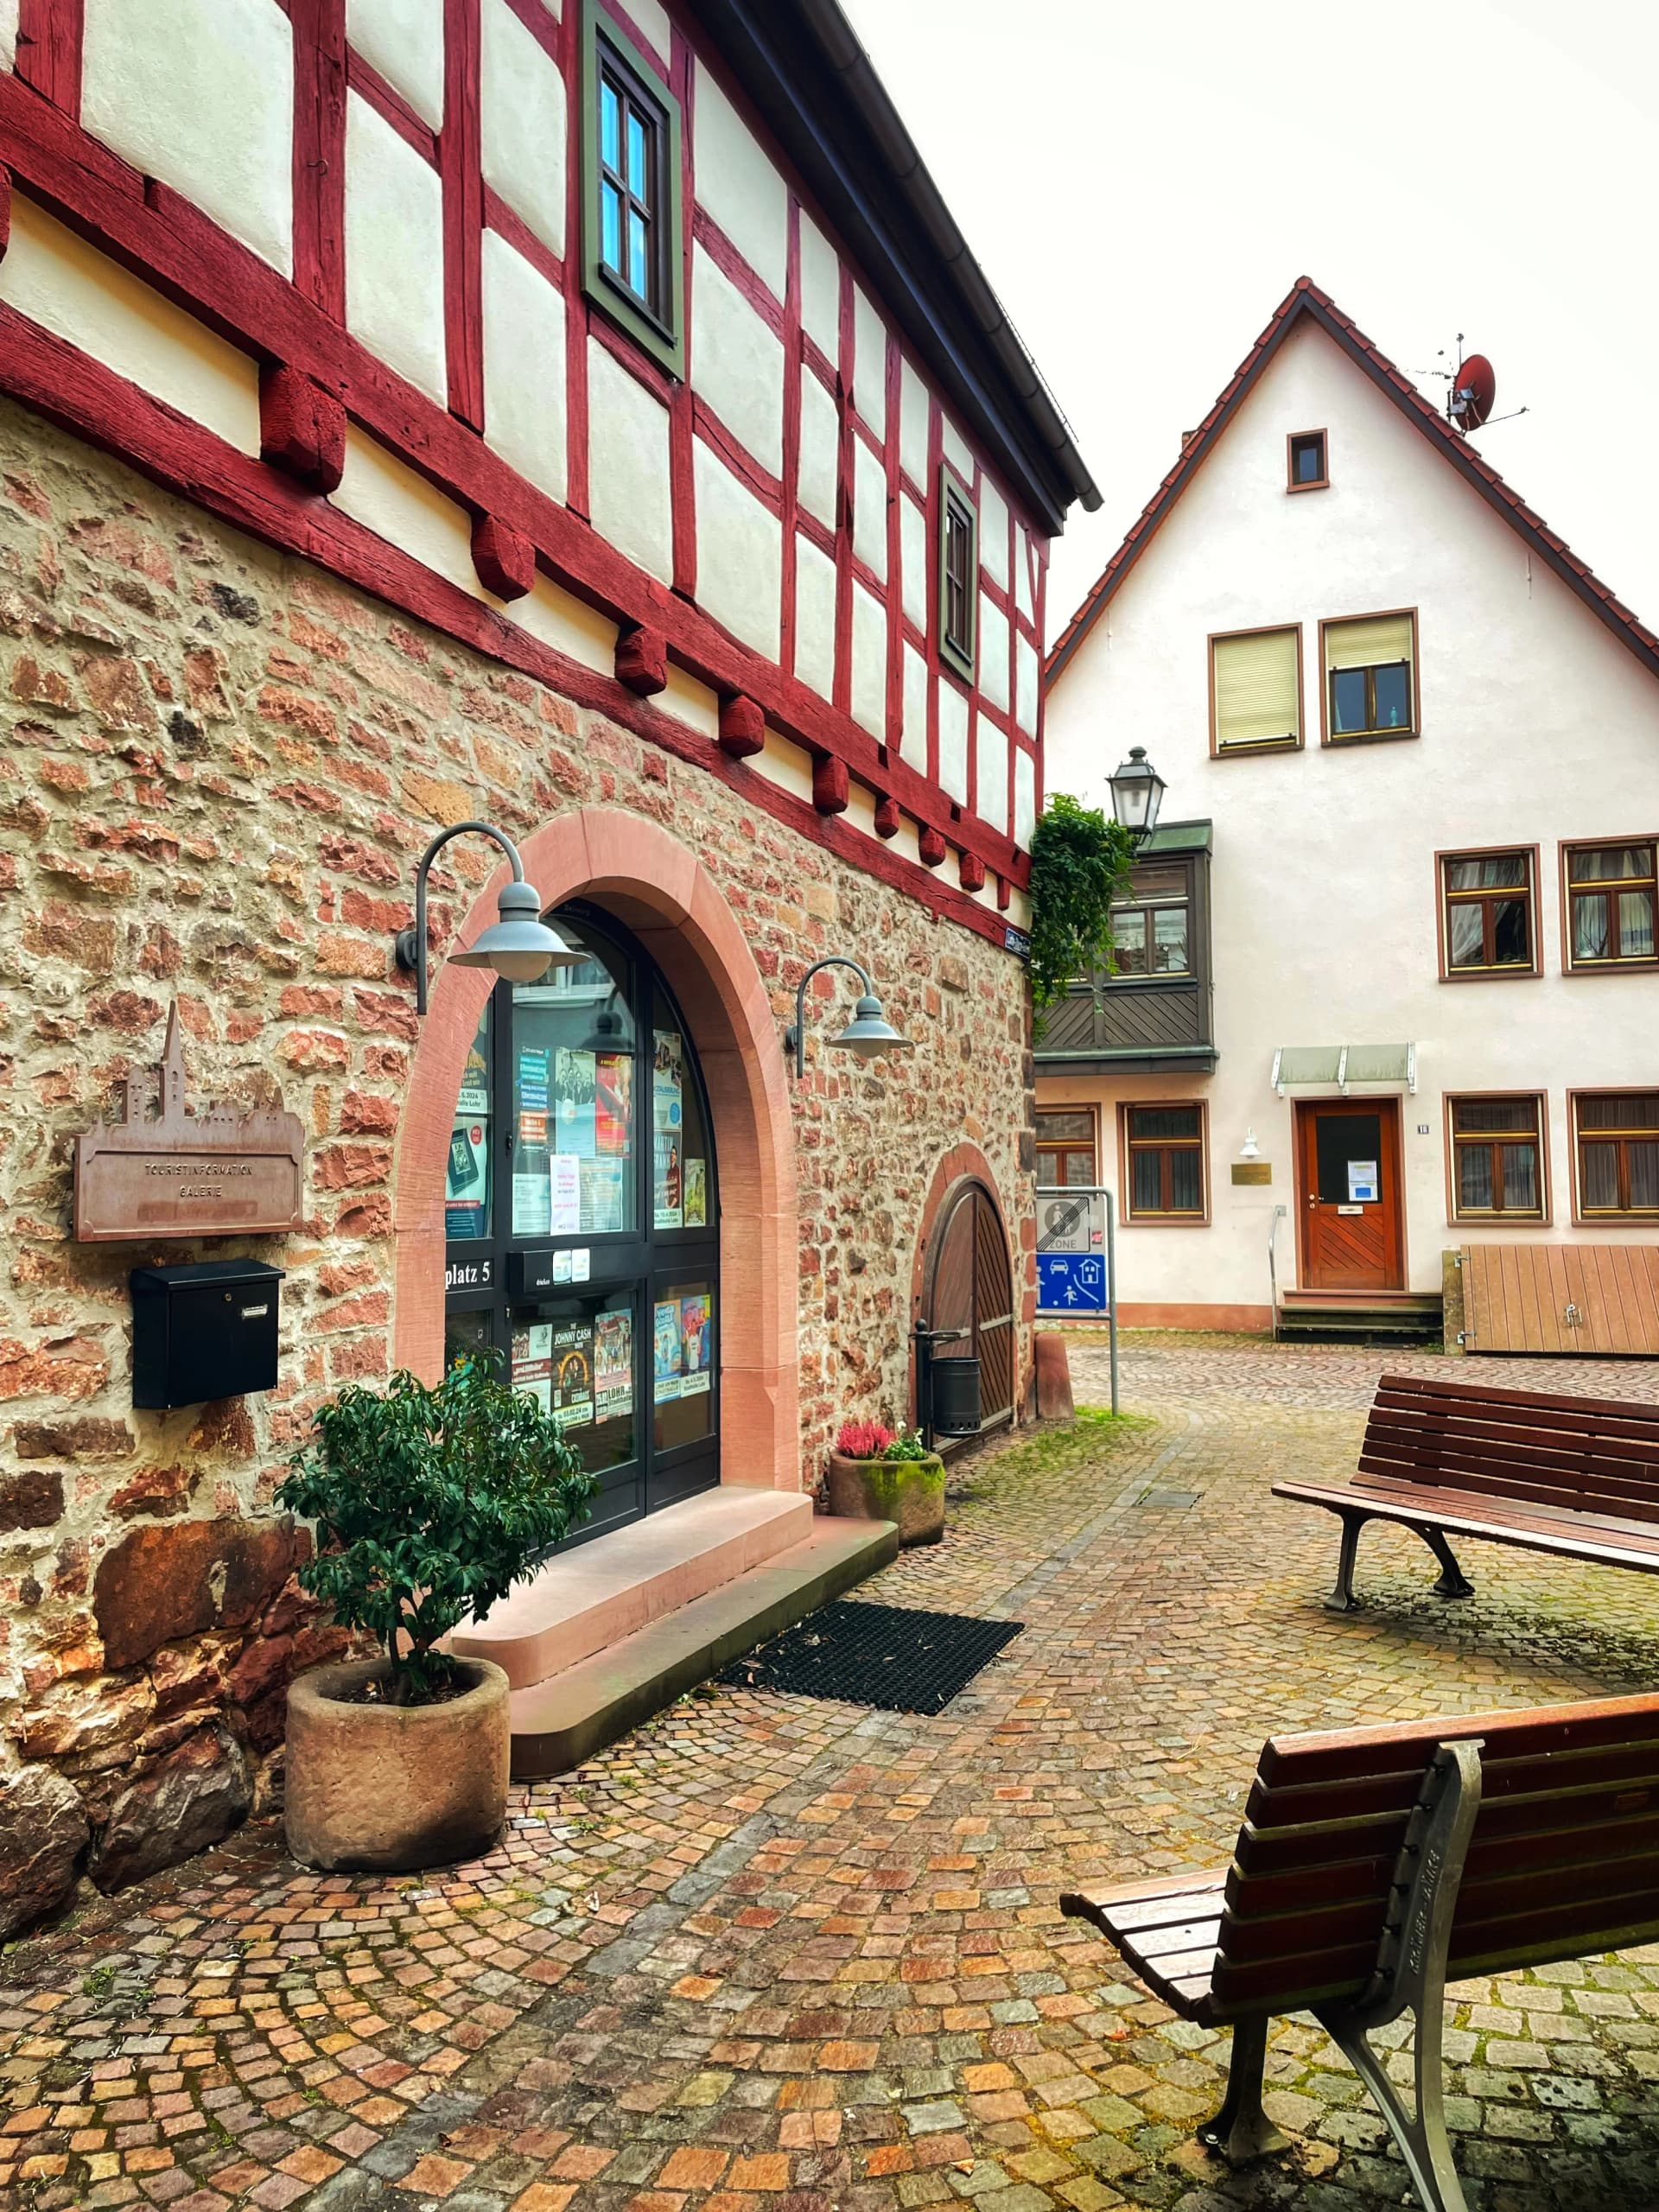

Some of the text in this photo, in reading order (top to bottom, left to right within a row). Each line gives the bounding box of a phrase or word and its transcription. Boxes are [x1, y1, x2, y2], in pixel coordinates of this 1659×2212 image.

[144, 1163, 253, 1176] TOURISTINFORMATION
[180, 1185, 222, 1198] GALERIE
[1050, 1239, 1077, 1249] ZONE
[482, 1261, 490, 1281] 5
[554, 1331, 576, 1346] JOHNNY
[576, 1327, 592, 1341] CASH
[607, 1385, 625, 1400] LOHR
